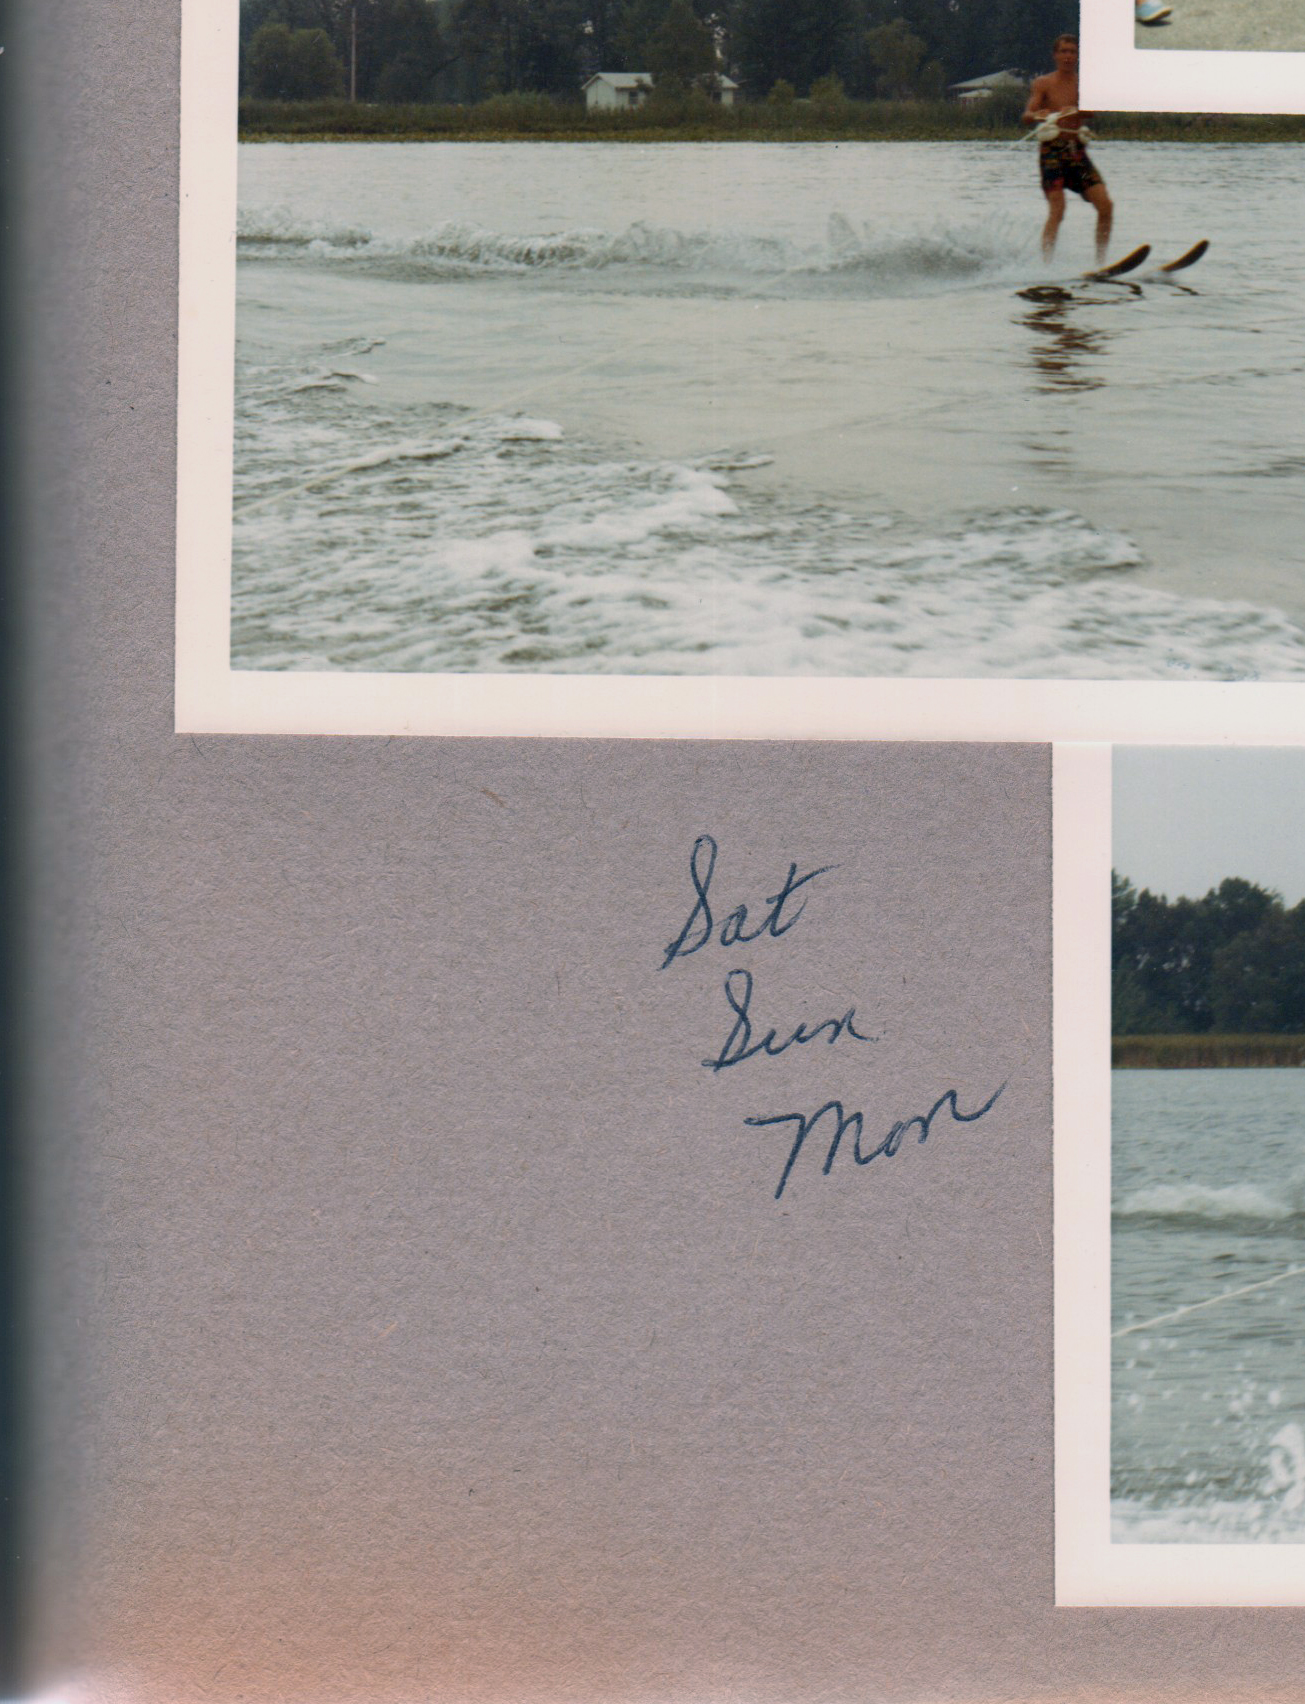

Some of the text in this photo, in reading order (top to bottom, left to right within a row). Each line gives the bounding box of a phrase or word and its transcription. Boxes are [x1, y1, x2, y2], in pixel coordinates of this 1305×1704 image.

[657, 834, 843, 971] Sat
[701, 969, 880, 1073] Sun
[743, 1081, 1009, 1200] Mon
